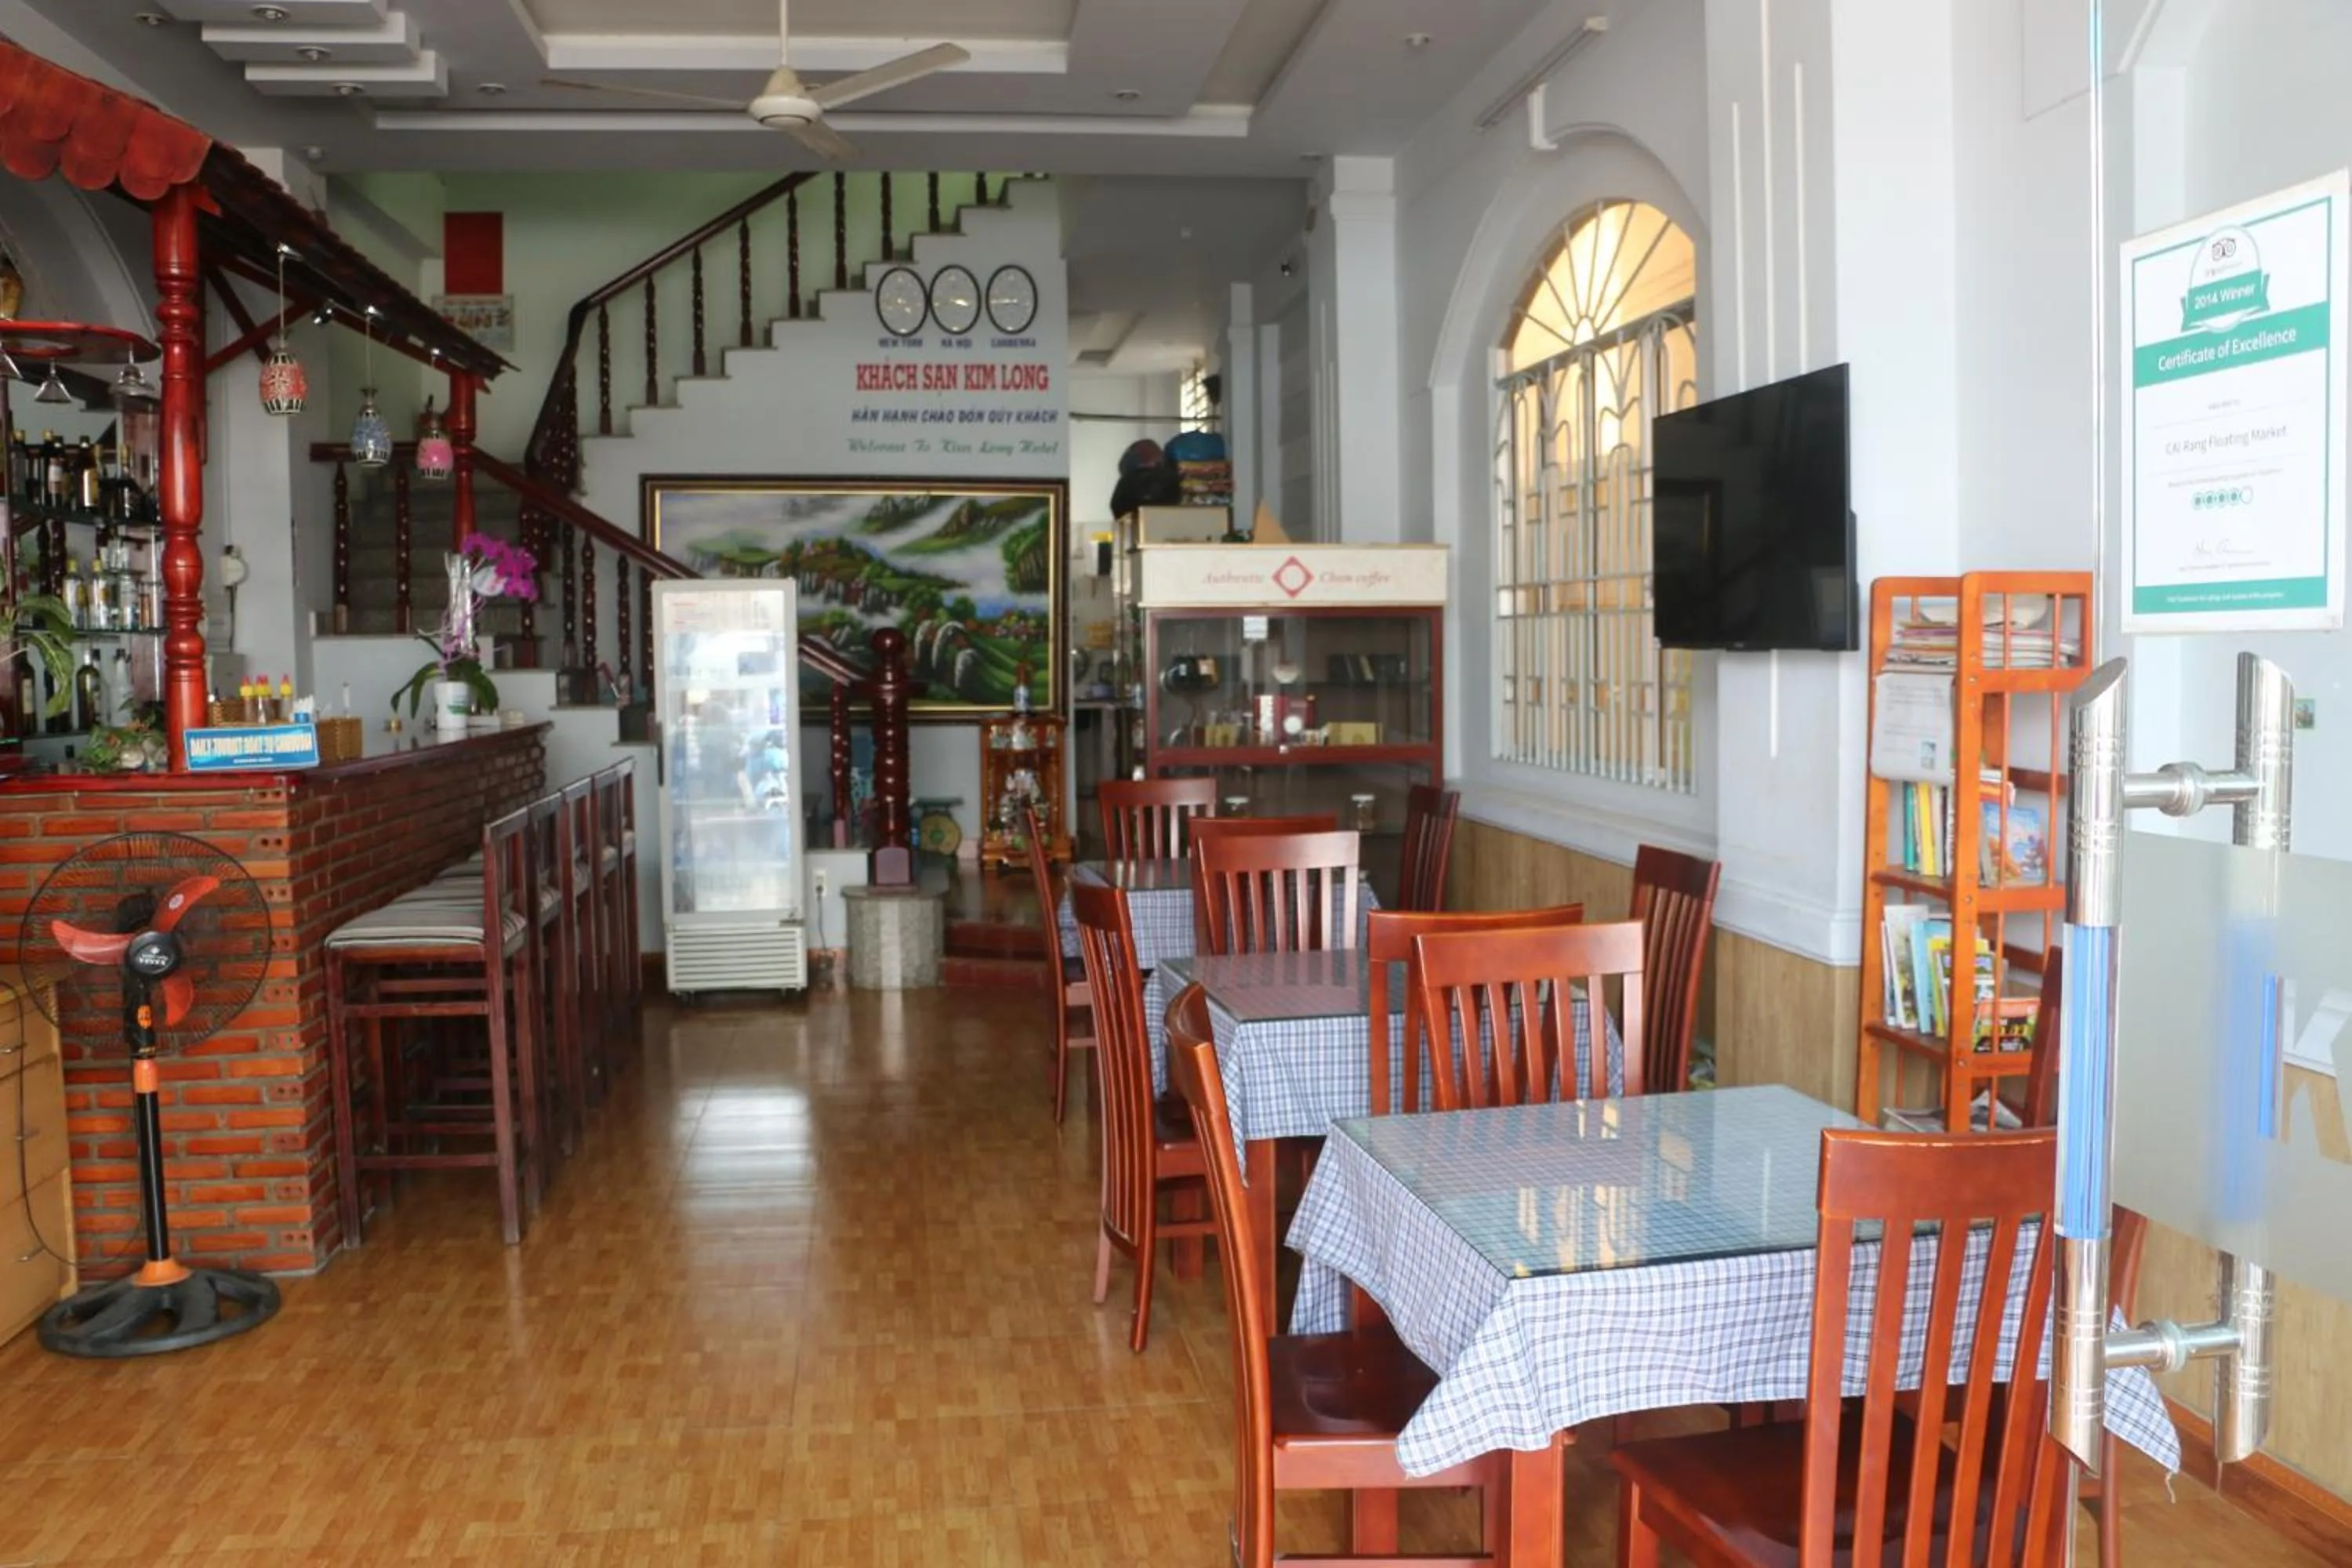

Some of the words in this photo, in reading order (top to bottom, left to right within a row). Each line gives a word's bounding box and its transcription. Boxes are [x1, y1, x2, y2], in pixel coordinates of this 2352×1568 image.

[2158, 347, 2215, 372] Certificate
[2217, 338, 2230, 358] of
[2232, 327, 2297, 354] Excellence
[964, 364, 996, 391] KIM
[1000, 364, 1050, 391] LONG
